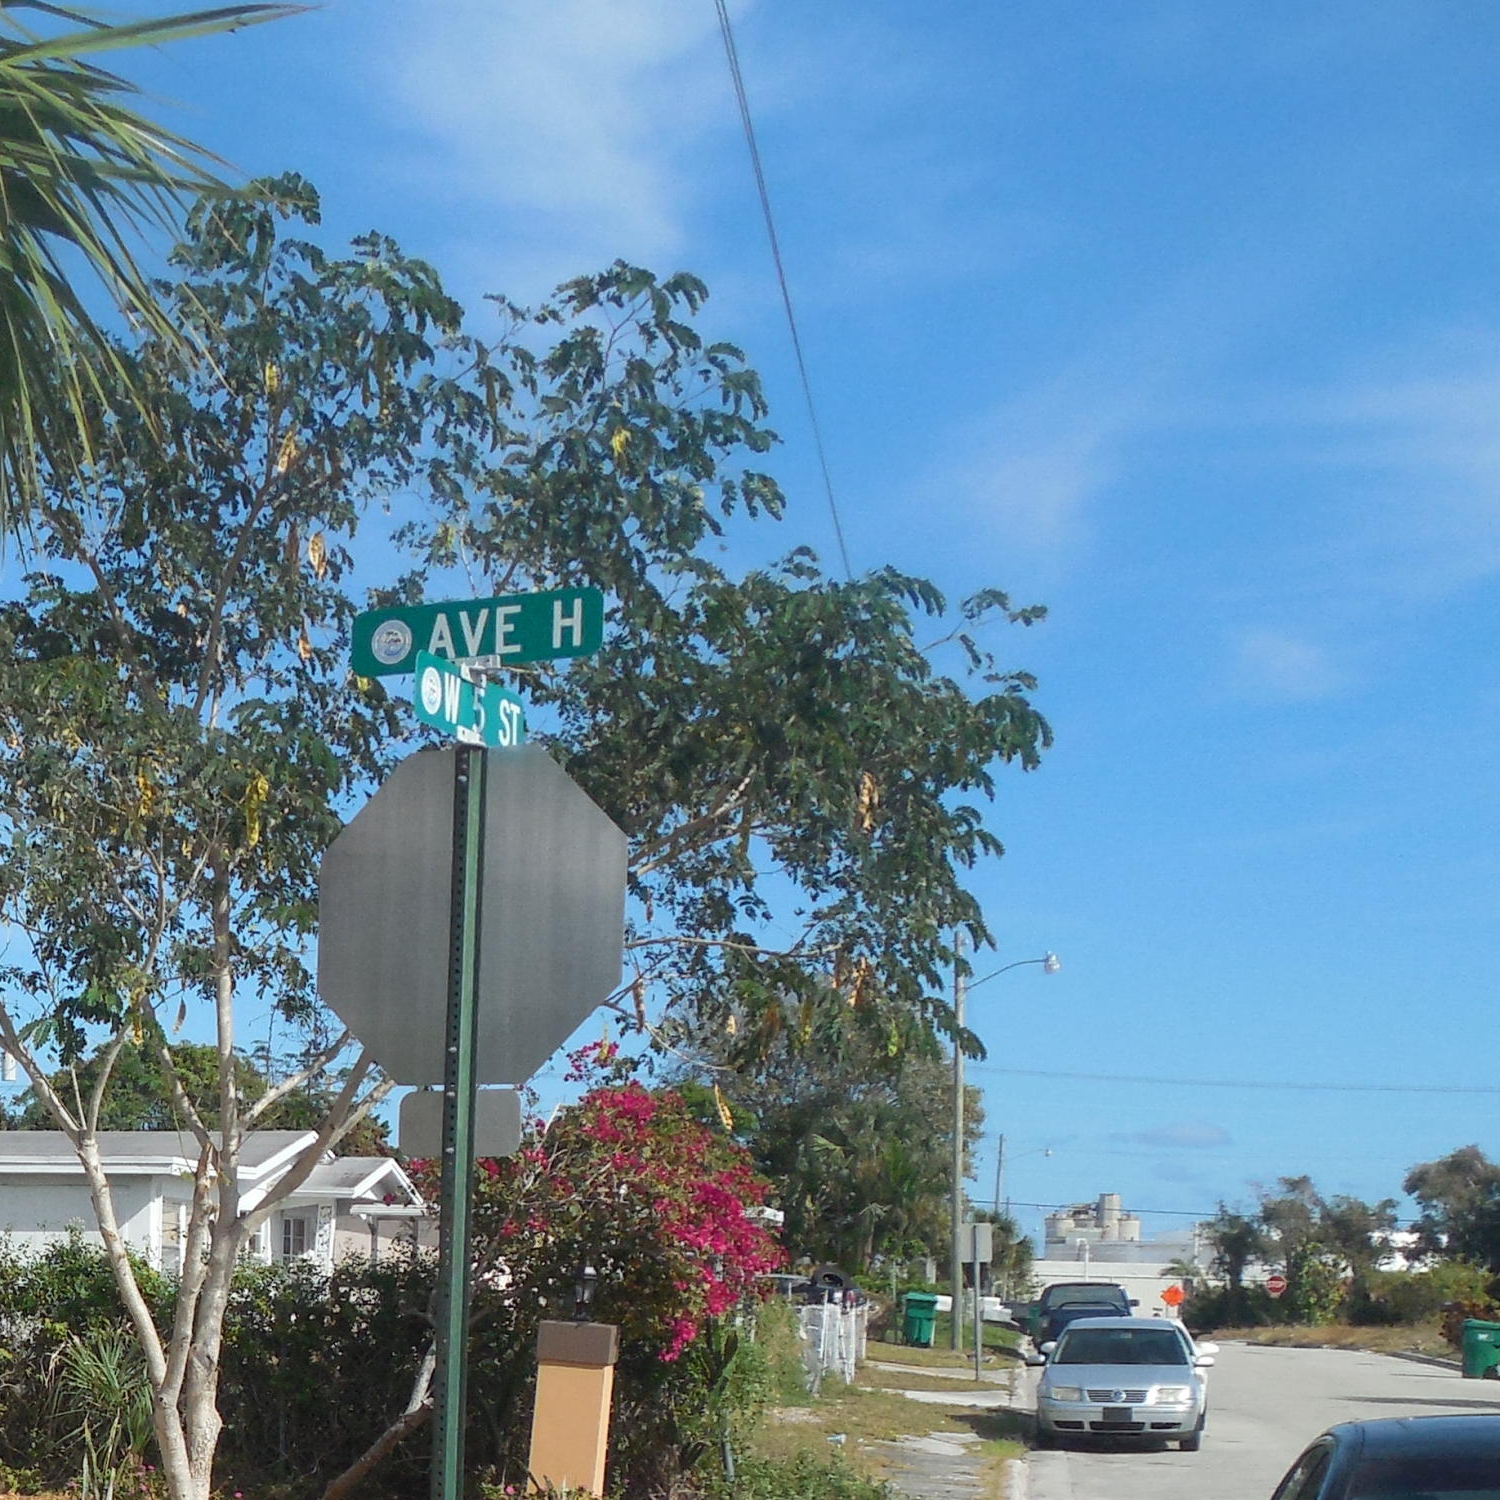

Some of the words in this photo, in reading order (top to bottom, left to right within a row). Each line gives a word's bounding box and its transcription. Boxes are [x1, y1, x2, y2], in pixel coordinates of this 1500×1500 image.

[428, 605, 522, 660] AVE
[552, 598, 583, 649] H
[444, 671, 462, 724] W
[498, 699, 521, 747] ST
